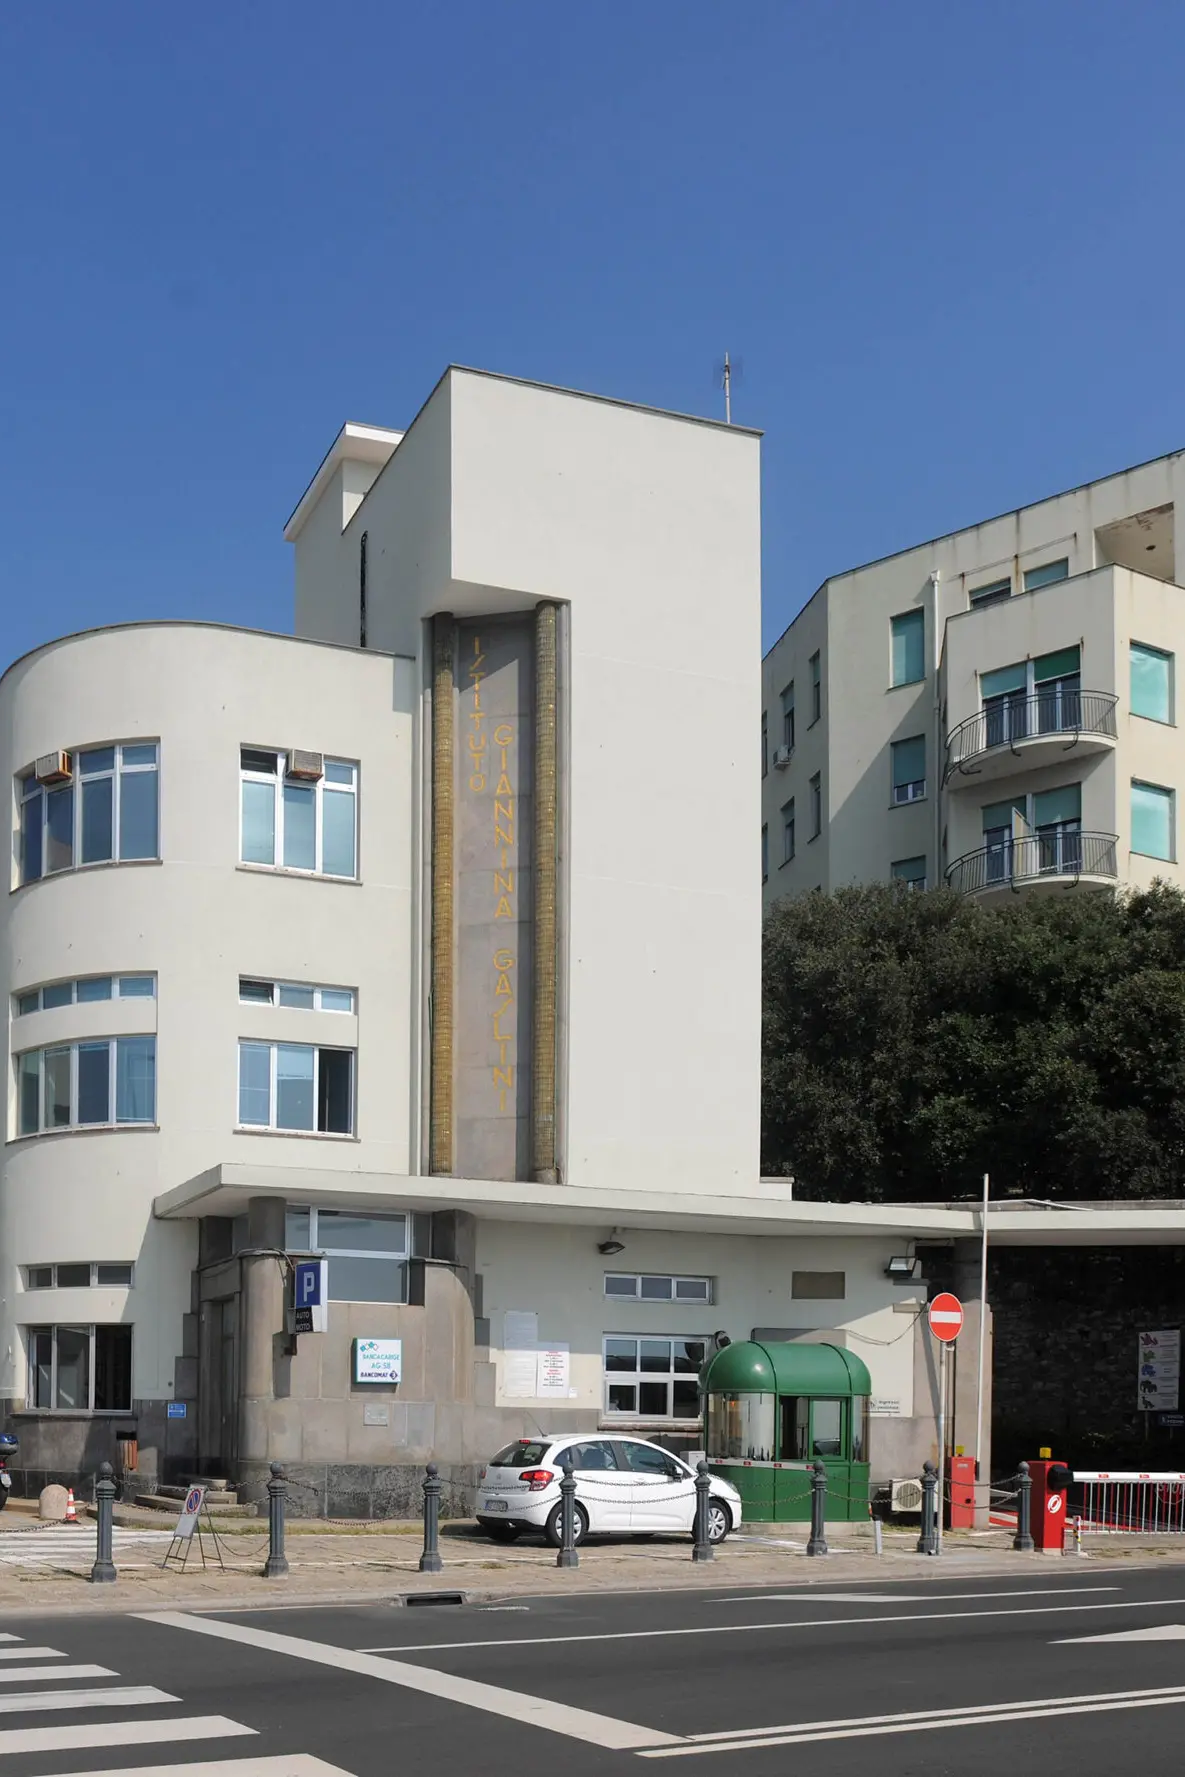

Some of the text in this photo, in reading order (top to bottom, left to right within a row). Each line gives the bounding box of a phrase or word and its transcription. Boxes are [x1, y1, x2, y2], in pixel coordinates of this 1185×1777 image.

[468, 637, 487, 793] ISTITUTO
[492, 724, 515, 1112] GIANNINA GASLINI
[303, 1271, 315, 1302] P
